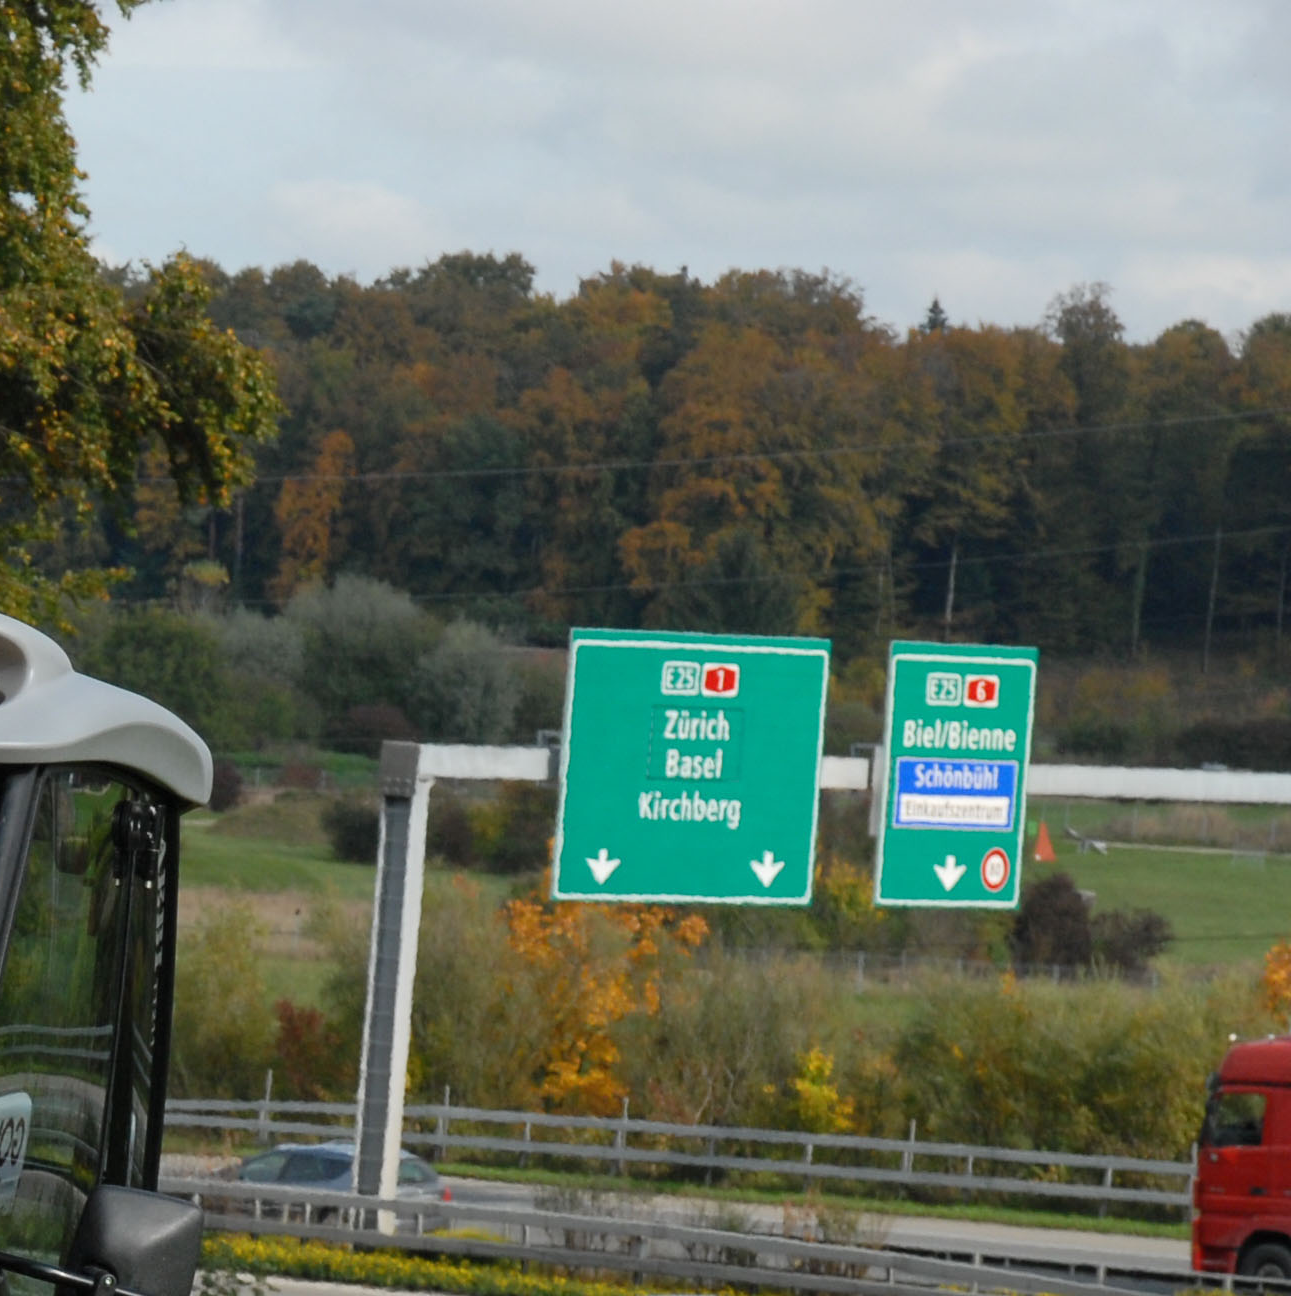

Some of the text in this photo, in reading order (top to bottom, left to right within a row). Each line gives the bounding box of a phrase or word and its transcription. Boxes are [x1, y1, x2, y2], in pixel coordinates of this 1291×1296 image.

[666, 666, 725, 690] E25 1
[930, 678, 987, 701] E25 6
[664, 709, 730, 741] Zürich
[903, 719, 1017, 752] Biel/Bienne
[666, 748, 722, 779] Basel
[914, 763, 999, 790] Schönbühl
[638, 792, 741, 829] Kirchberg
